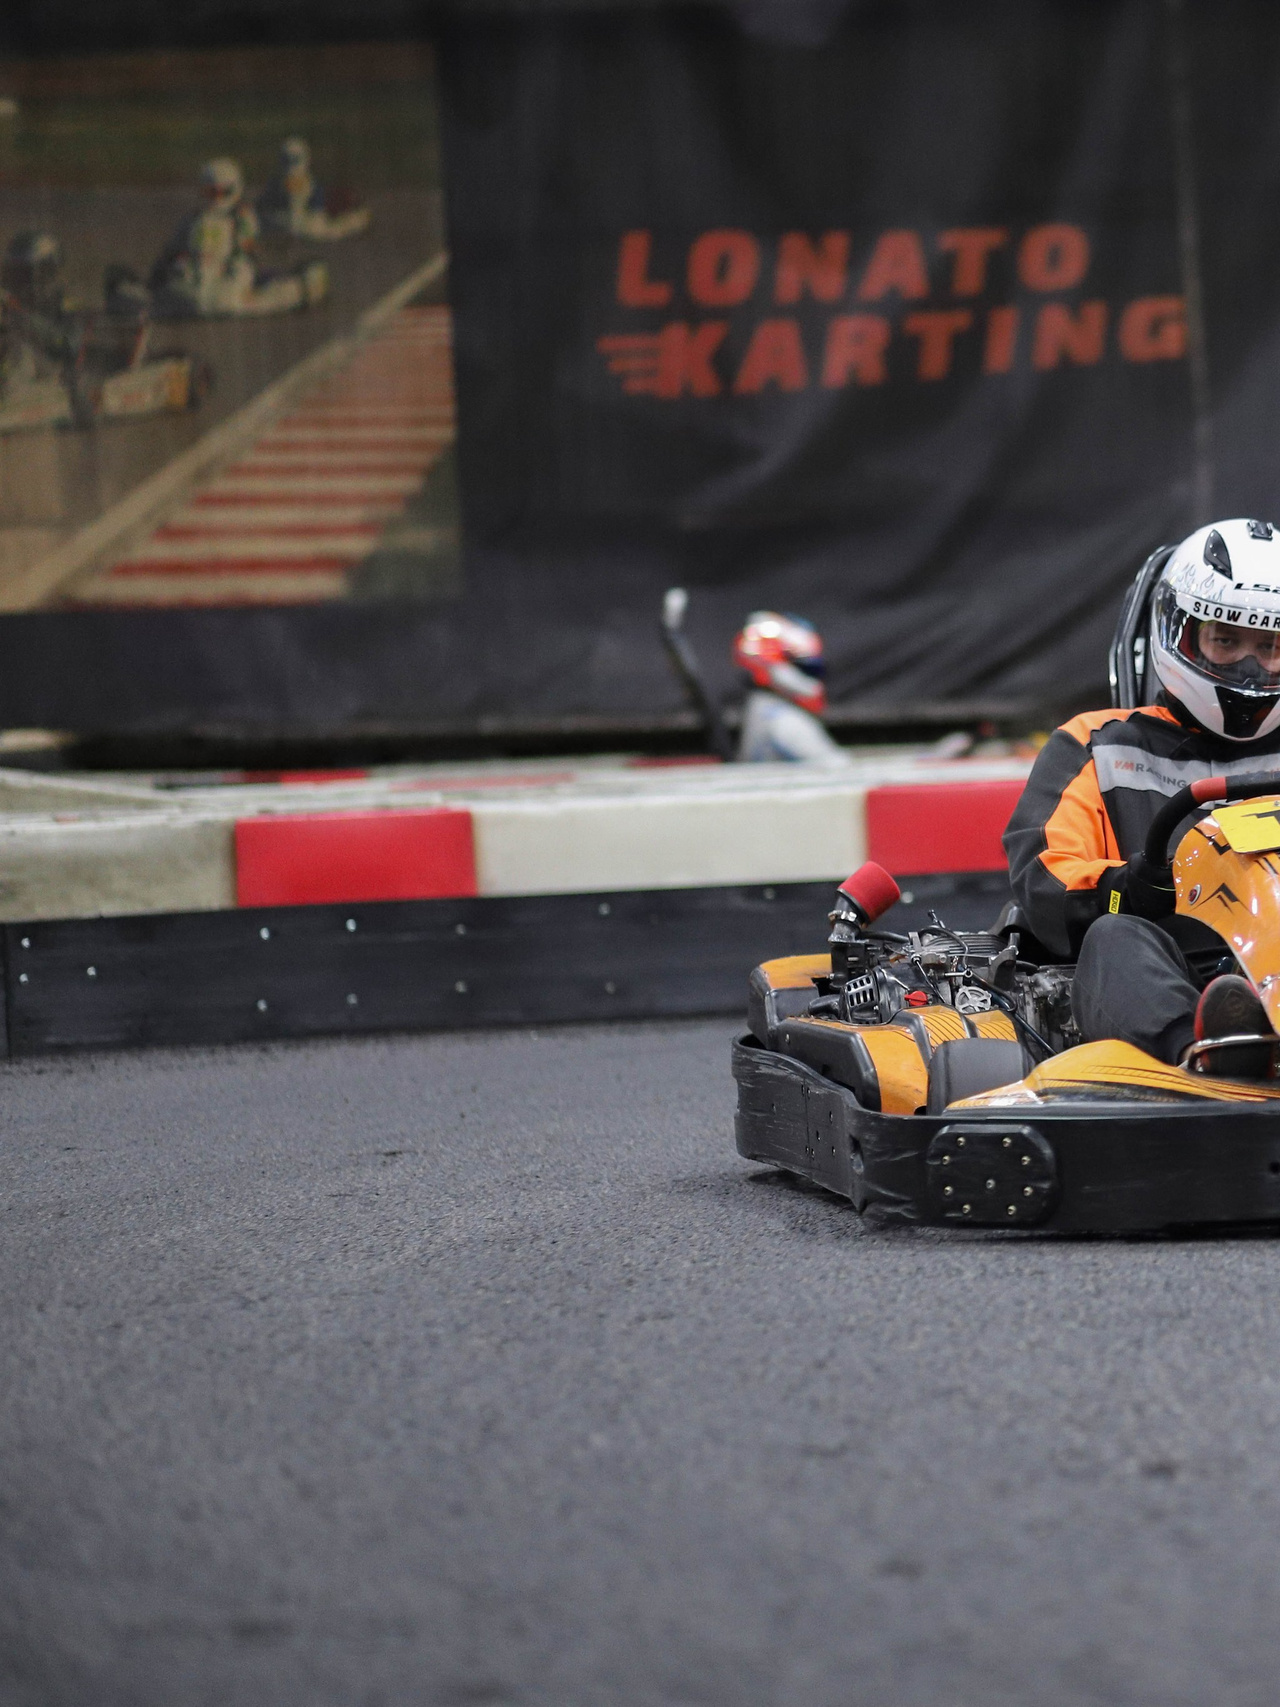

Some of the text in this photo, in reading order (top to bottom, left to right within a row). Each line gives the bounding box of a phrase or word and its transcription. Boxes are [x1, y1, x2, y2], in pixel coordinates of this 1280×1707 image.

[617, 223, 1090, 306] LONATO
[597, 294, 1188, 398] KARTING
[1193, 601, 1242, 623] SLOW
